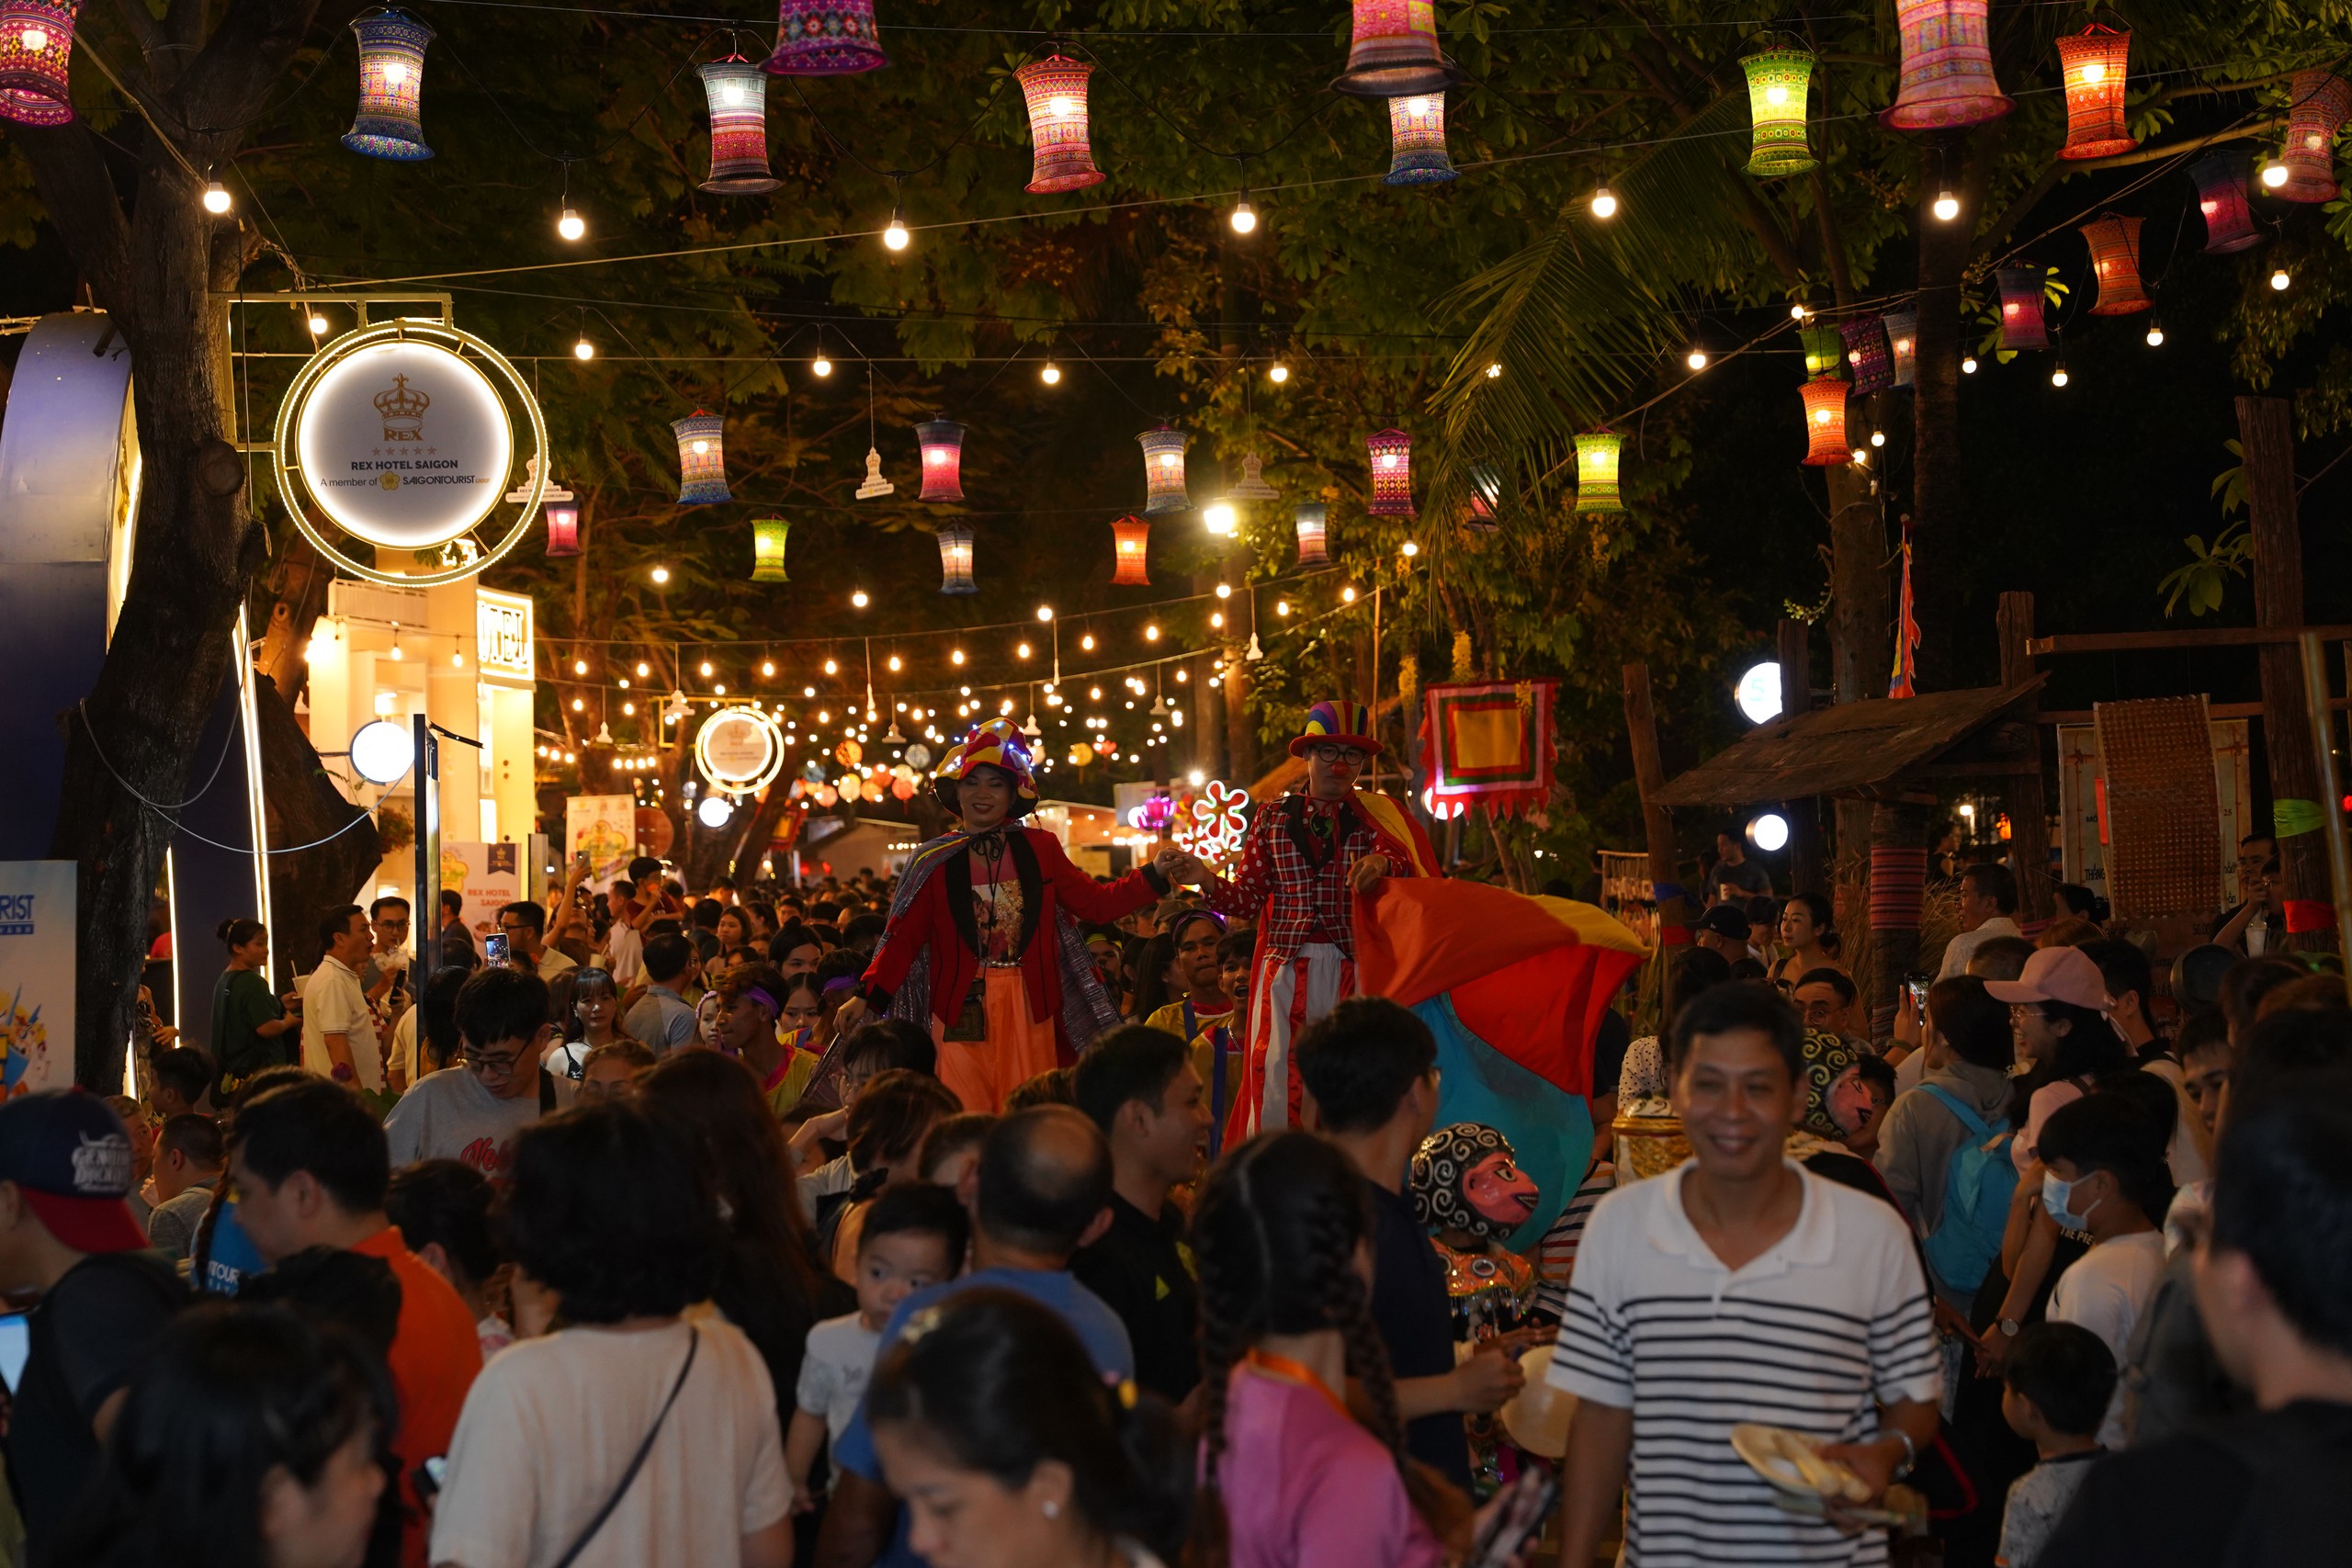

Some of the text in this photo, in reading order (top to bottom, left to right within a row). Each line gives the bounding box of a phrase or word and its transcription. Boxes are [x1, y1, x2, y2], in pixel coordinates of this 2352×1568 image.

[383, 426, 424, 442] REX
[351, 459, 458, 470] REX HOTEL SAIGON
[320, 478, 328, 488] A
[329, 478, 367, 487] member
[368, 477, 378, 486] of
[402, 475, 475, 485] SAIGONTOURIST
[467, 888, 511, 897] REX HOTEL
